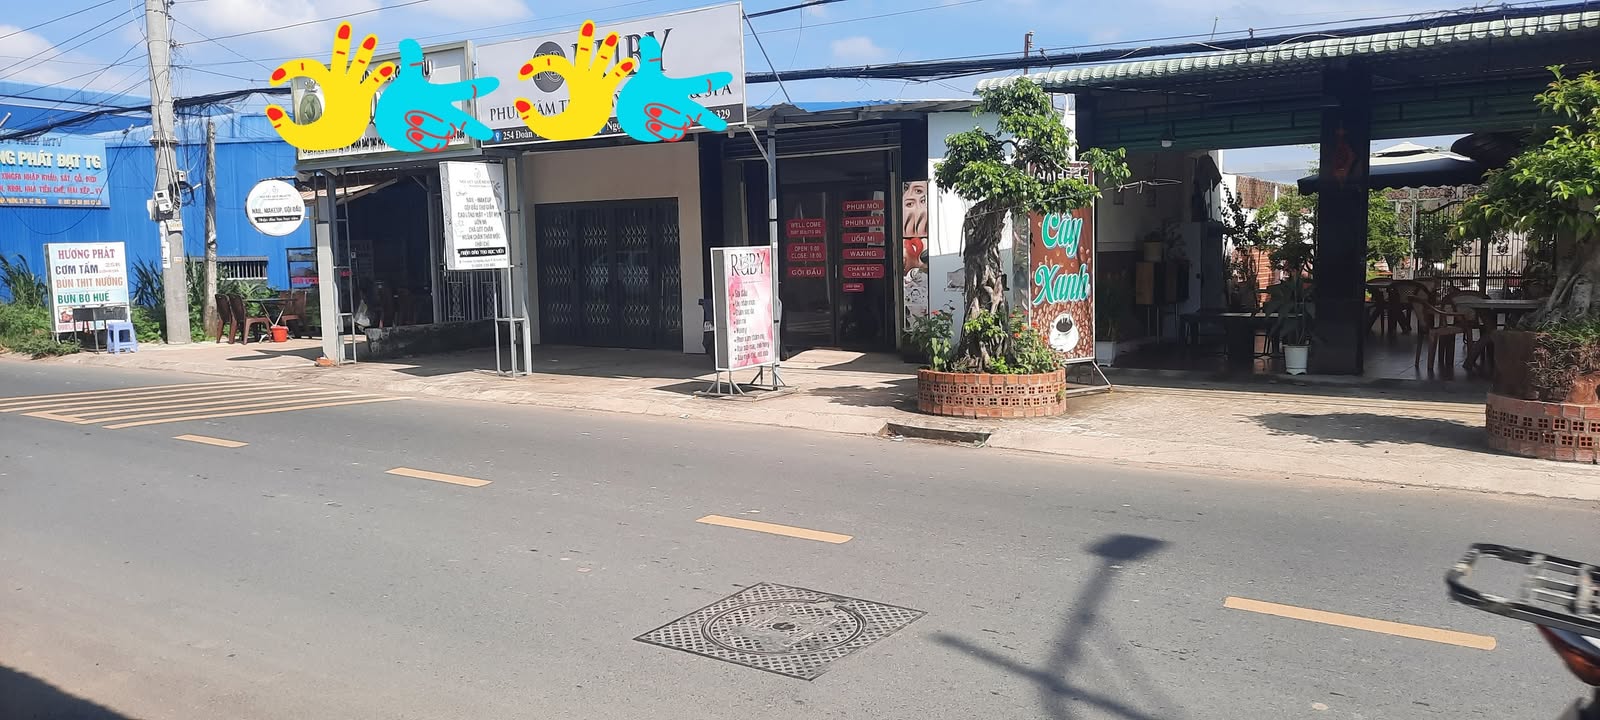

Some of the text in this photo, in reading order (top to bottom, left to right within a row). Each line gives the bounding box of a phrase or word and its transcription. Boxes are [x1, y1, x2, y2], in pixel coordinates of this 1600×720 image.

[503, 131, 514, 140] 254
[516, 129, 533, 139] Đoàn
[18, 149, 54, 168] PHÁT
[57, 153, 81, 171] ĐẠT
[84, 154, 102, 170] TG
[1042, 210, 1083, 258] Cây
[58, 246, 115, 260] HƯƠNG PHÁT
[55, 264, 77, 275] CƠM
[79, 261, 99, 274] TẤM
[730, 252, 766, 277] RUBY
[791, 266, 821, 277] GỘI ĐẦU
[56, 275, 123, 289] BÚN THỊT NƯỚNG
[1032, 264, 1090, 305] Xanh
[57, 290, 110, 304] BÚN BÒ HUẾ
